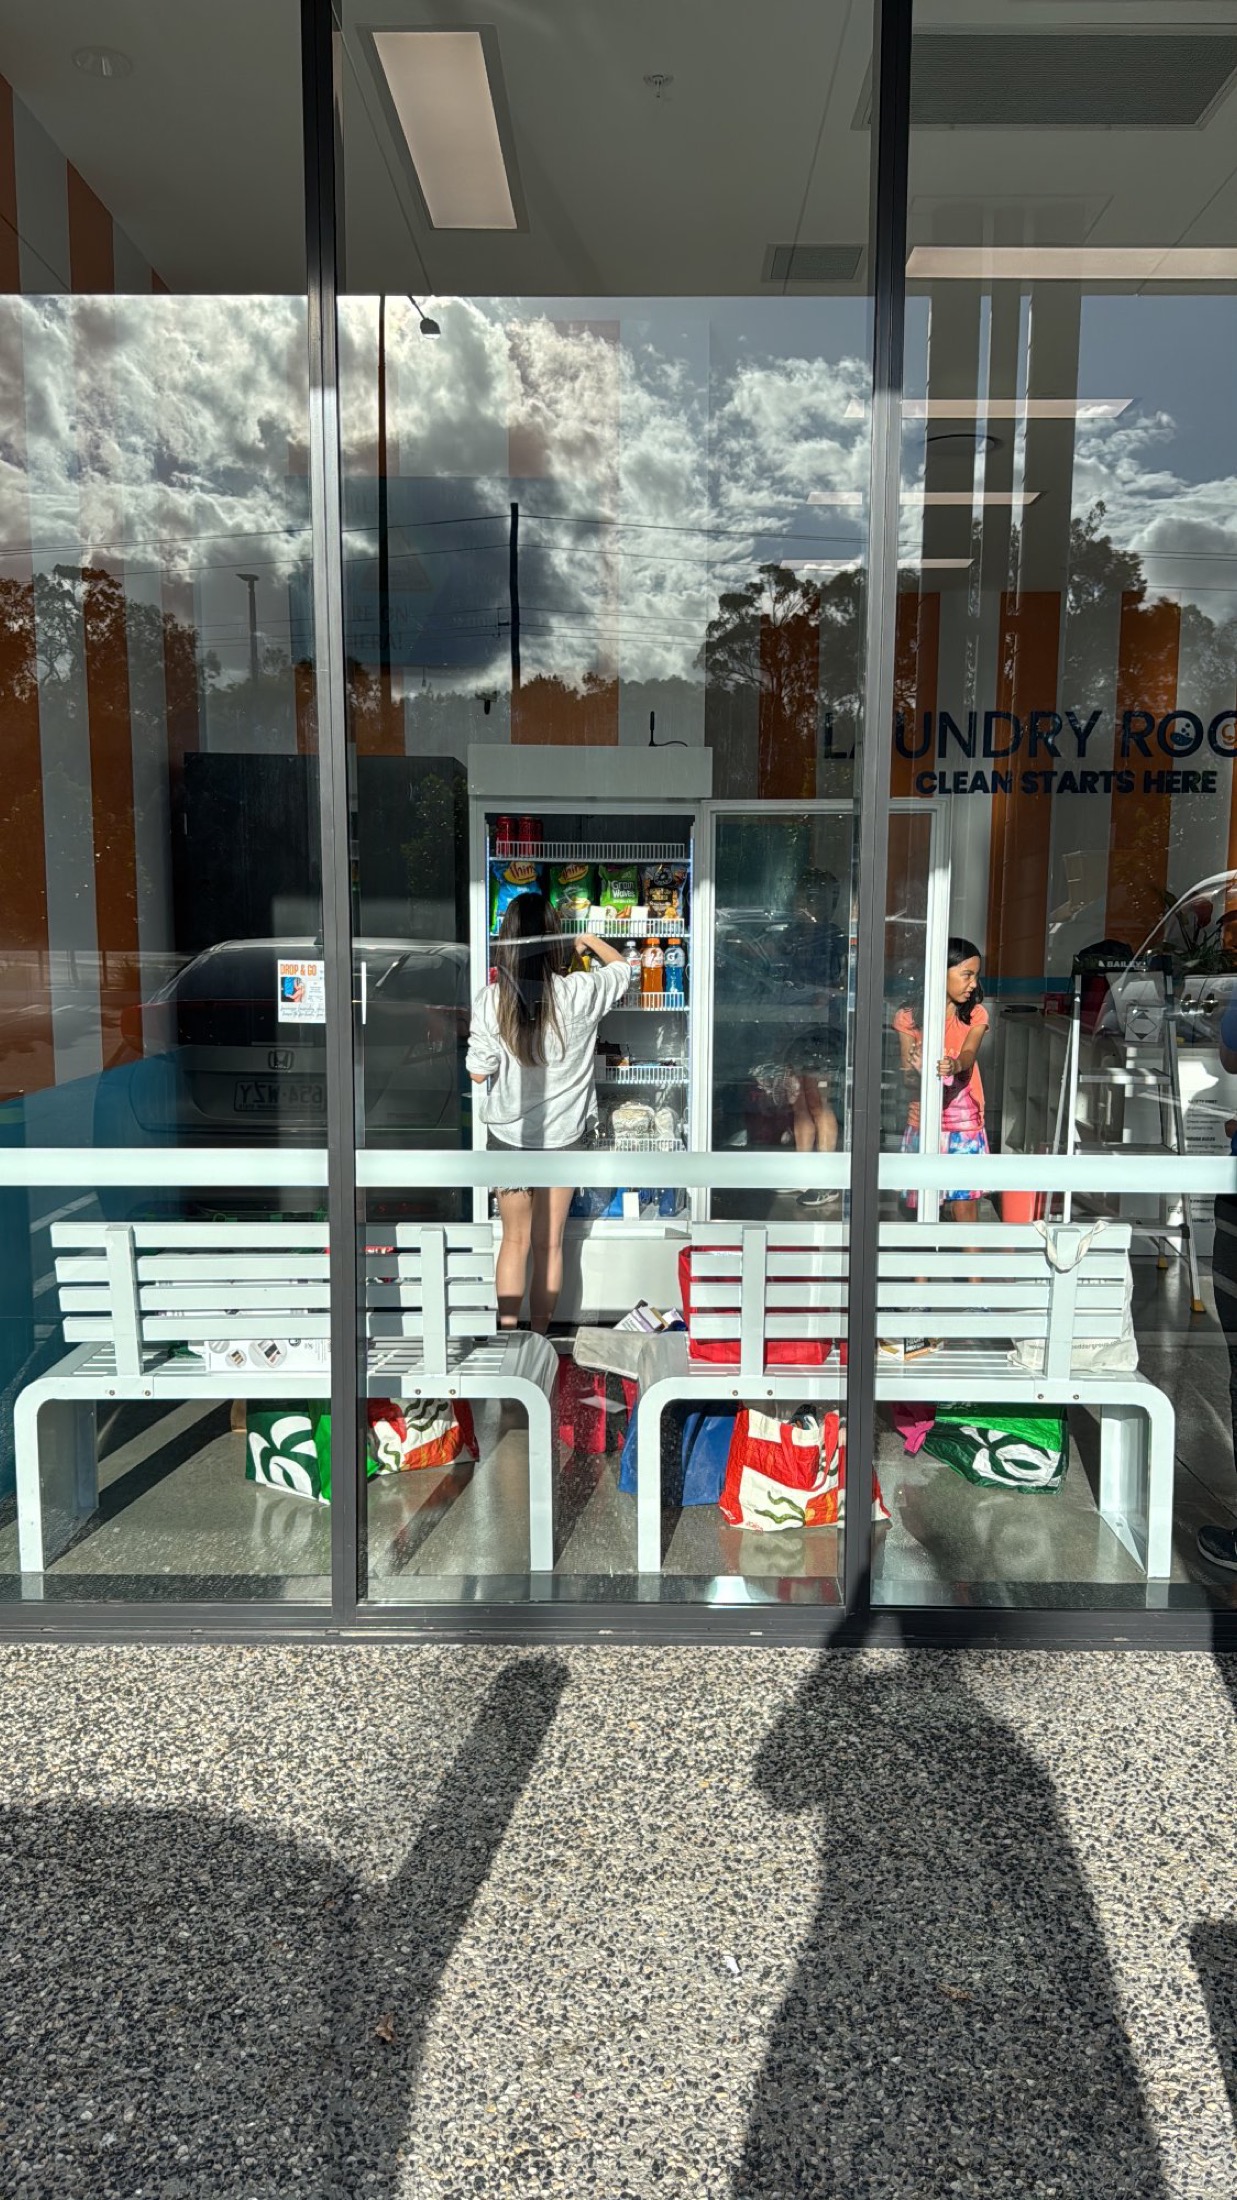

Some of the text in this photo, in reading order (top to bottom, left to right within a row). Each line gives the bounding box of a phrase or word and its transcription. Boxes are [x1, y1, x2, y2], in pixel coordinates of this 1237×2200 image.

[824, 711, 1102, 759] LUNDRY
[915, 770, 1217, 794] CLEAN STARTS HERE
[611, 880, 634, 890] Grain
[612, 890, 635, 898] Waves
[280, 964, 299, 975] DROP
[301, 964, 305, 976] &
[308, 964, 317, 976] GO
